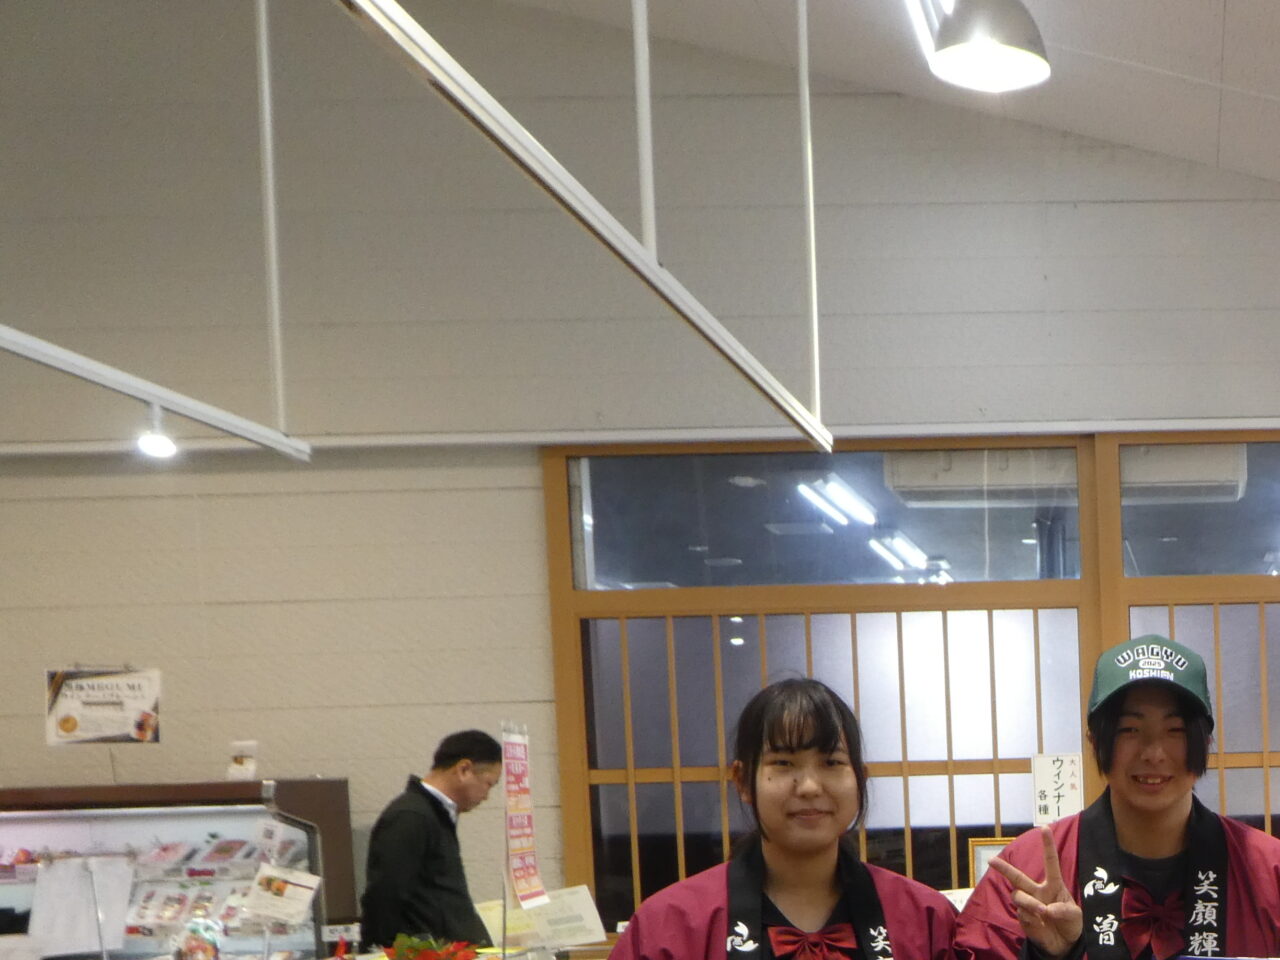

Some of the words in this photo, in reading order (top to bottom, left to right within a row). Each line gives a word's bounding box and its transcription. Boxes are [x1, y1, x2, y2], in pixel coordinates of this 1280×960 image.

[1114, 644, 1188, 670] WAGYU
[1052, 755, 1065, 817] ウィンナー
[1069, 758, 1078, 791] 大人気
[1038, 789, 1050, 816] 各種
